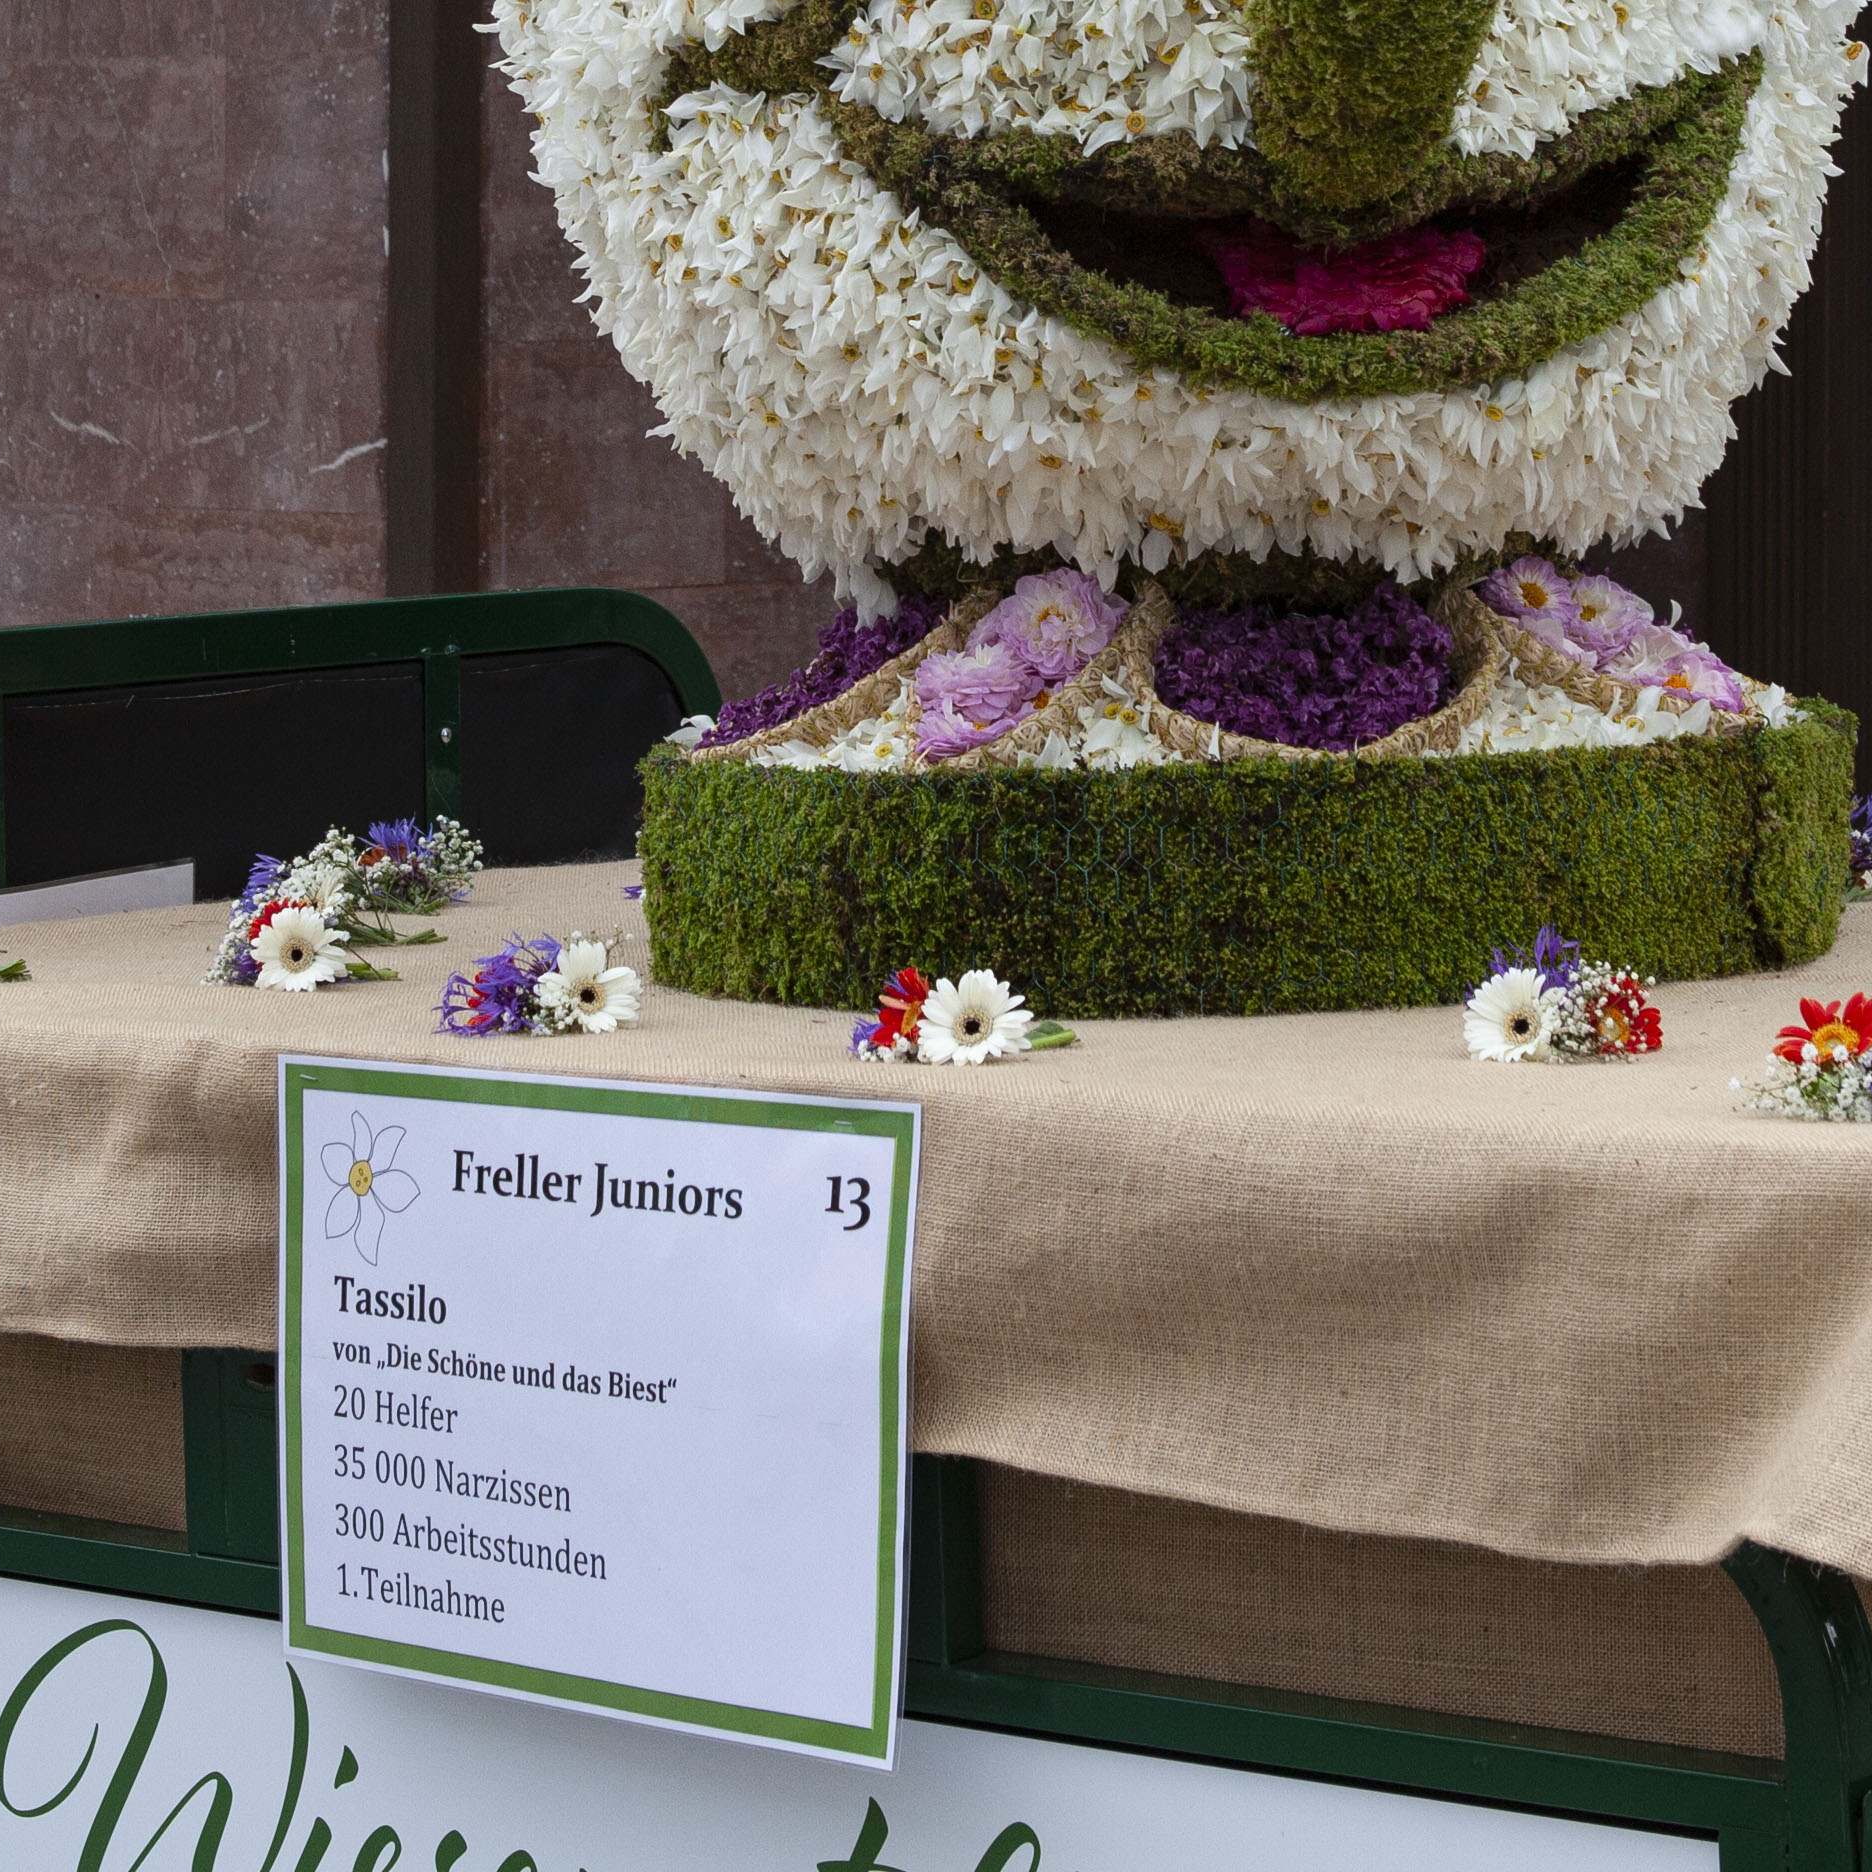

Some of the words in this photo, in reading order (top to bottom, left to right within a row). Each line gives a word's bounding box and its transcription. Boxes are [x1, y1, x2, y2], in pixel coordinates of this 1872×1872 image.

[451, 1149, 582, 1204] Freller
[590, 1162, 744, 1220] Juniors
[825, 1174, 872, 1231] 13
[334, 1275, 447, 1325] Tassilo
[333, 1340, 371, 1366] von
[376, 1342, 422, 1372] „Die
[427, 1348, 506, 1384] Schöne
[512, 1357, 556, 1388] und
[561, 1362, 602, 1395] das
[608, 1369, 678, 1404] Biest“
[334, 1384, 366, 1420] 20
[375, 1389, 459, 1434] Helfer
[334, 1443, 366, 1480] 35
[375, 1449, 426, 1489] 000
[435, 1459, 572, 1512] Narzissen
[335, 1502, 385, 1542] 300
[393, 1513, 607, 1580] Arbeitsstunden
